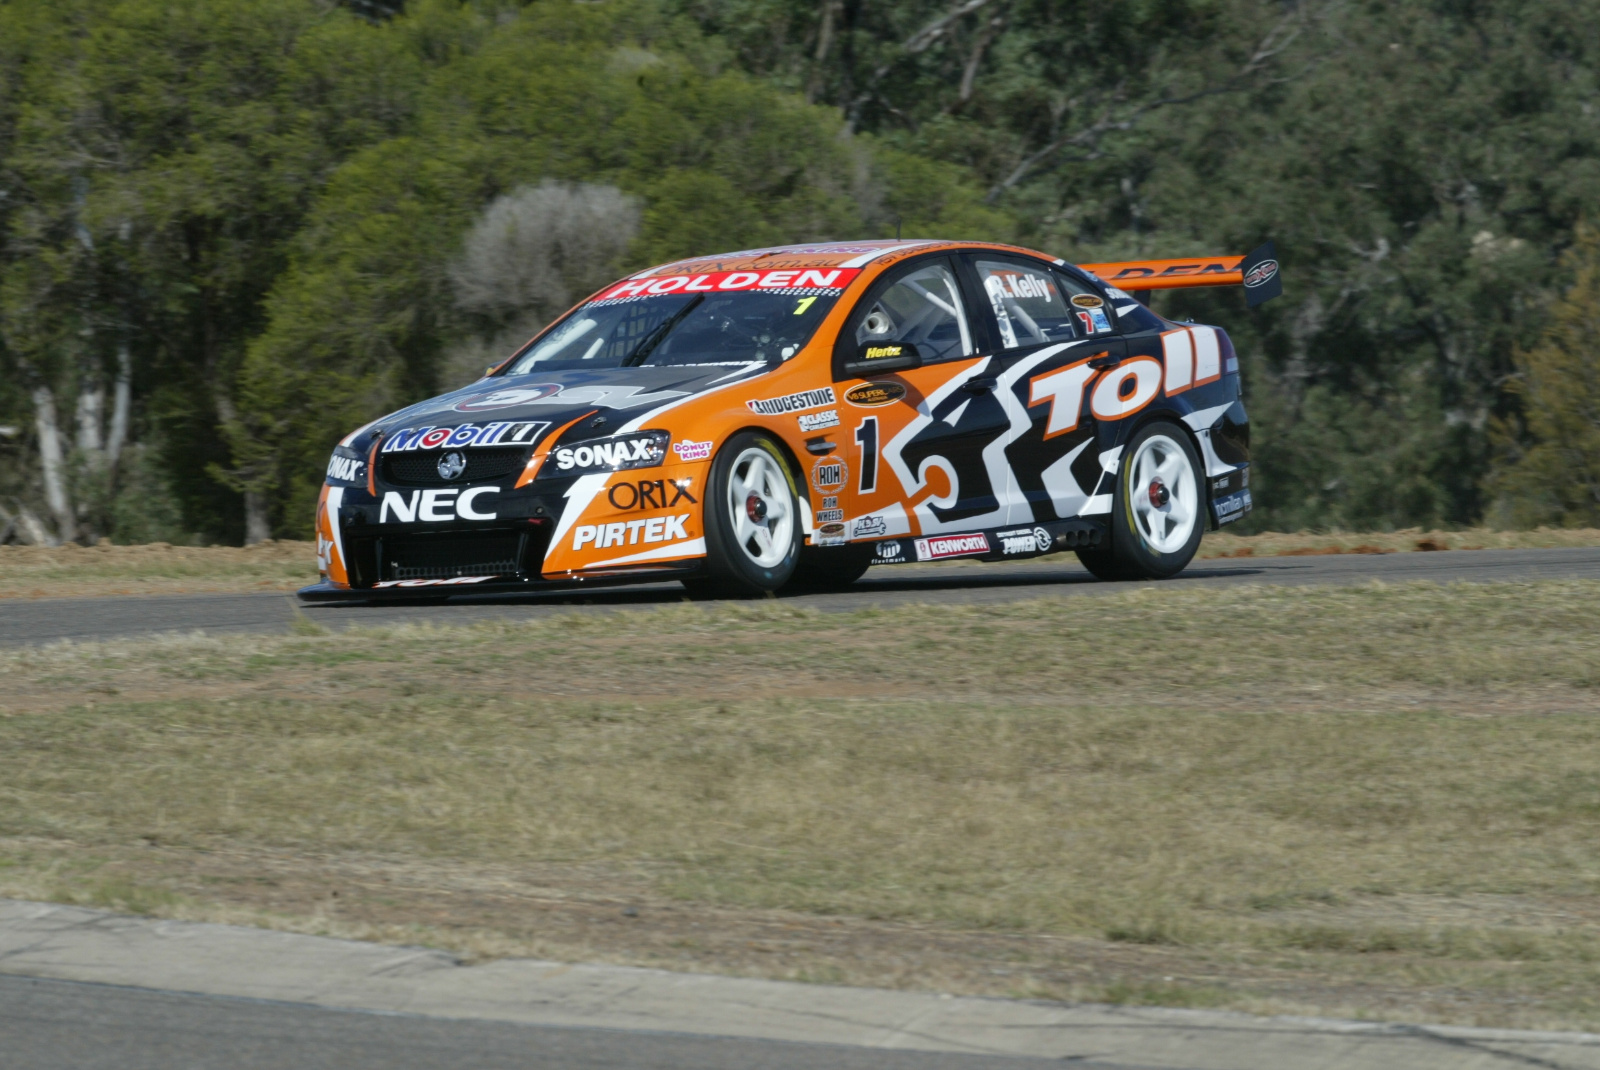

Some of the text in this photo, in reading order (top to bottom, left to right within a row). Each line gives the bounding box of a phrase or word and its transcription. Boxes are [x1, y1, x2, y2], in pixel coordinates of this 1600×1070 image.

[605, 269, 842, 299] HOLDEN
[990, 273, 1052, 303] R.Kelly
[793, 296, 818, 315] 1
[865, 346, 902, 359] Hertz
[1027, 324, 1222, 441] Toll
[748, 388, 834, 415] BRIDGESTONE
[381, 422, 509, 453] Mobil
[674, 442, 713, 453] DONUT
[556, 438, 653, 470] SONAX
[682, 449, 709, 461] KING
[854, 415, 879, 495] 1
[818, 464, 841, 486] ROH
[379, 486, 500, 523] NEC
[608, 477, 698, 510] ORIX
[823, 496, 838, 509] ROH
[816, 509, 843, 523] WHEELS
[572, 513, 691, 551] PIRTEK
[930, 535, 987, 556] KENWORTH
[1000, 536, 1036, 554] POWER
